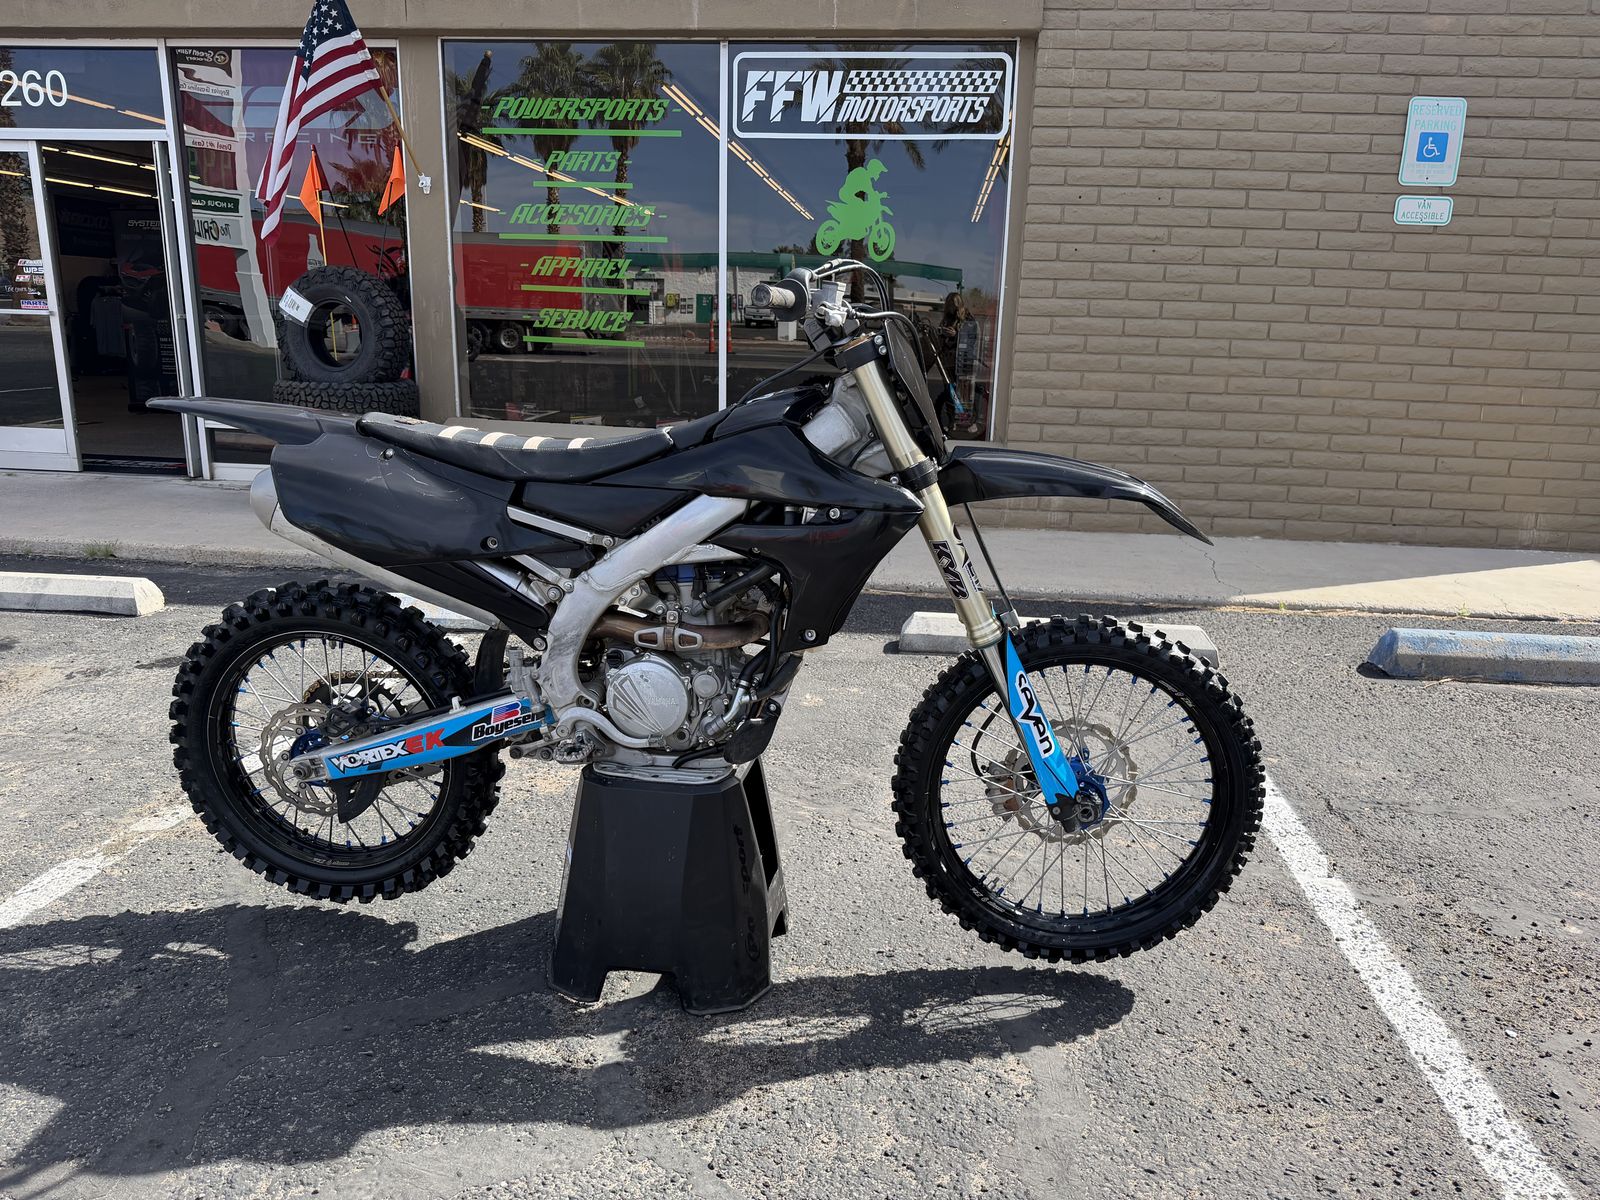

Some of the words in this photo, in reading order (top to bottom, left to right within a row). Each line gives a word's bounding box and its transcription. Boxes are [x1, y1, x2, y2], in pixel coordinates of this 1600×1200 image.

[0, 70, 68, 107] 260
[742, 70, 843, 124] FFW
[493, 97, 671, 121] POWERSPORTS
[837, 96, 990, 123] MOTORSPORTS
[1412, 104, 1462, 116] RESERVED
[1414, 120, 1456, 131] PARKING
[543, 150, 622, 172] PARTS
[509, 204, 657, 227] ACCESORIES
[1401, 211, 1445, 220] ACCESSIBLE
[1417, 202, 1431, 210] VAN
[531, 256, 634, 279] APPAREL
[533, 308, 634, 332] SERVICE
[472, 711, 541, 741] Boyesen
